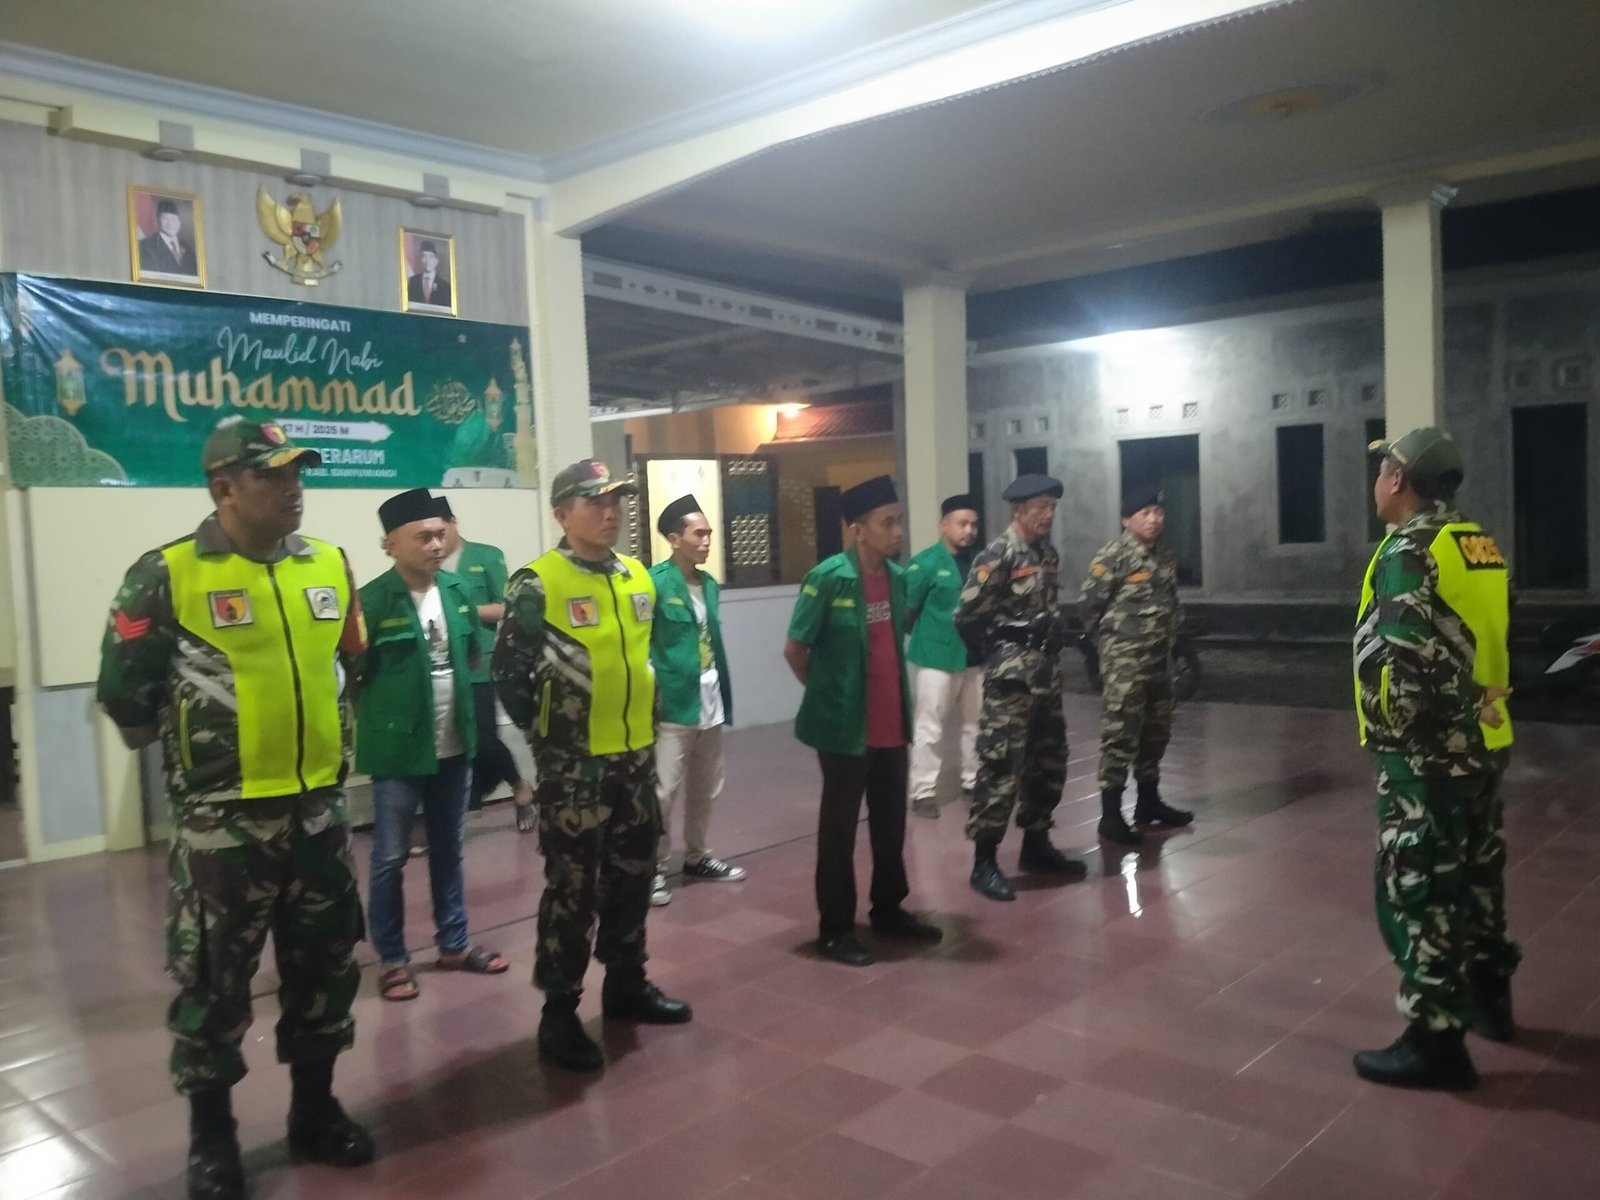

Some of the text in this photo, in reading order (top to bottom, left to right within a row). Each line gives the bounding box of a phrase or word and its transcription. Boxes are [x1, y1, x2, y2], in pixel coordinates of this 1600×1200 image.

[249, 312, 351, 333] MEMPERINGATI
[217, 326, 384, 376] Maulid Nabi
[101, 348, 421, 422] Muhammad
[313, 425, 338, 435] 2025
[340, 426, 349, 435] M
[313, 448, 385, 465] ERARUM
